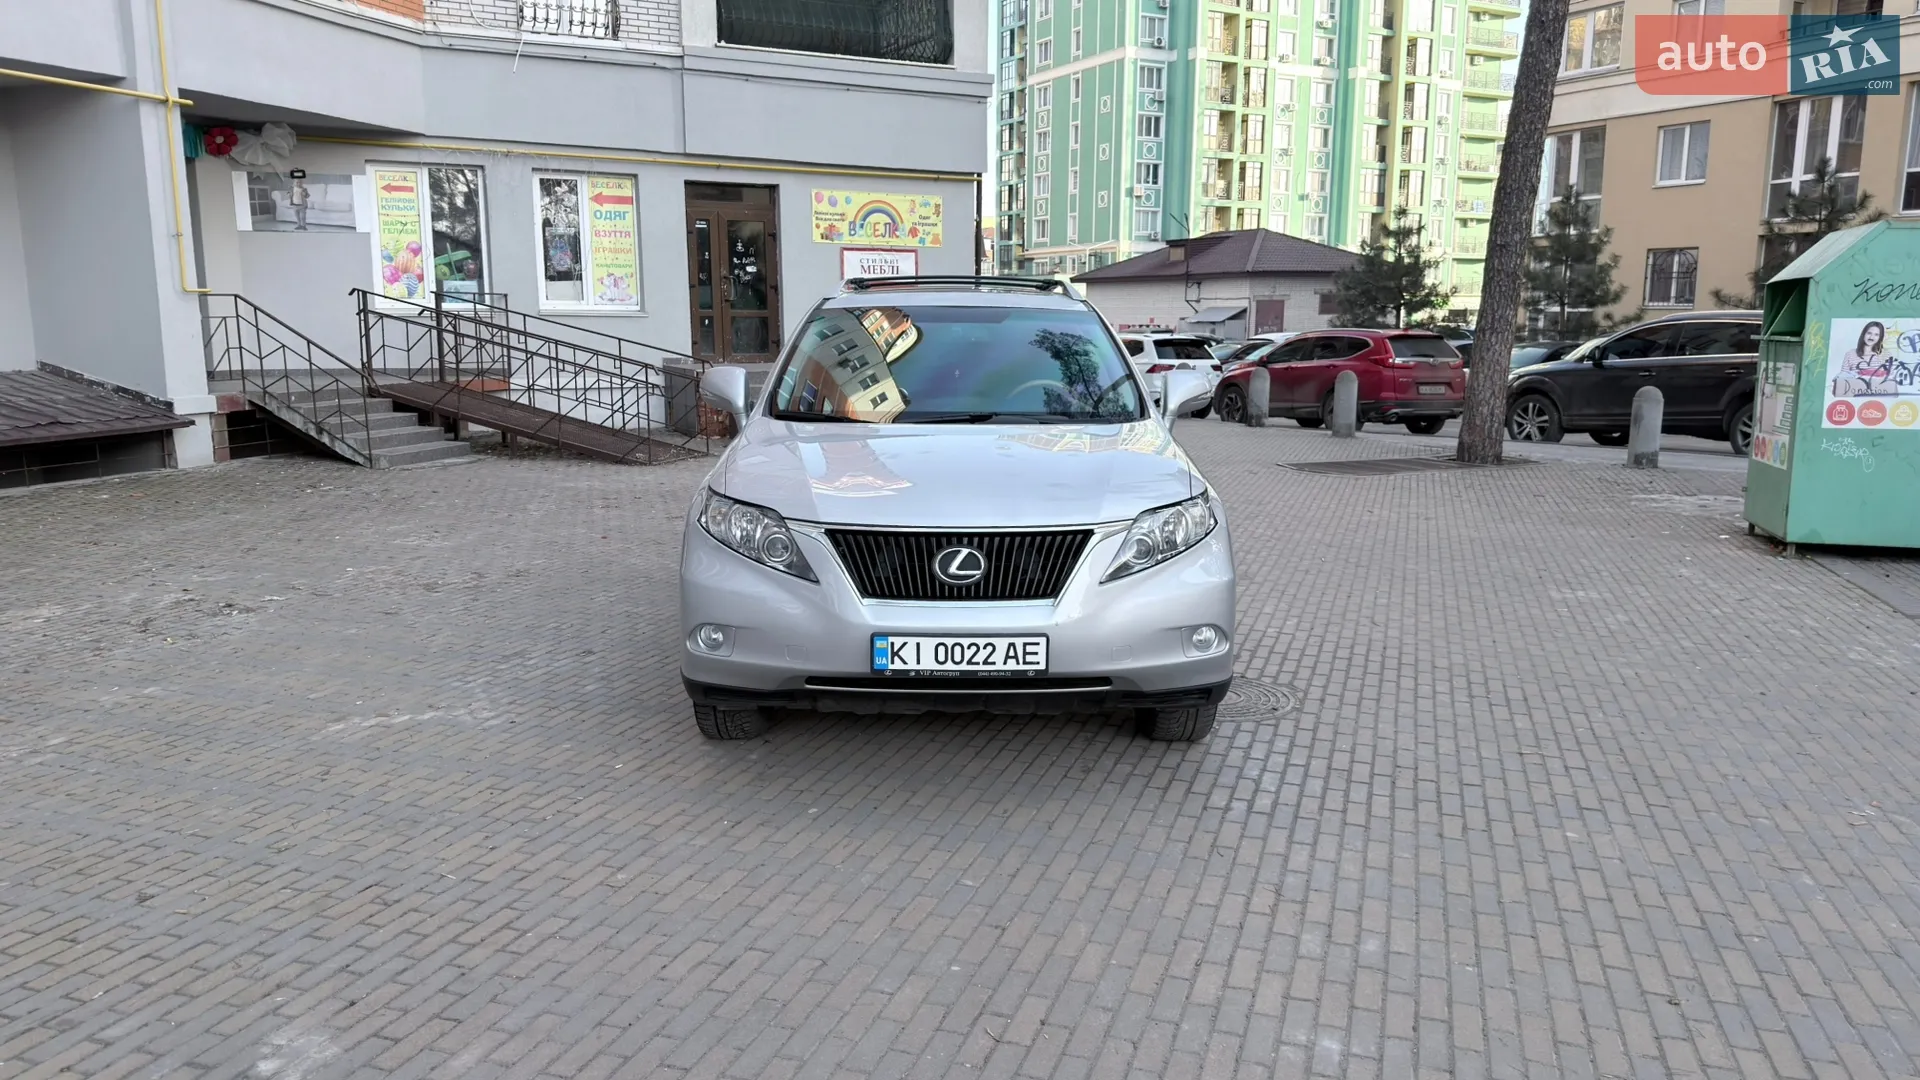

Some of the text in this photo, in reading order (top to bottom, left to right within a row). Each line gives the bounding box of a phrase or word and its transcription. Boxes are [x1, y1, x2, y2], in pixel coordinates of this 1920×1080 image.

[380, 204, 416, 212] КУЛЬКИ
[593, 209, 630, 221] ОДЯГ
[594, 229, 631, 238] ВЗУТТЯ
[848, 220, 907, 239] ВЕСЕЛКА
[859, 257, 899, 265] СТИЛЬНІ
[860, 264, 900, 275] МЕБЛІ
[889, 641, 1041, 666] KI 0022 AE
[875, 656, 888, 665] UA
